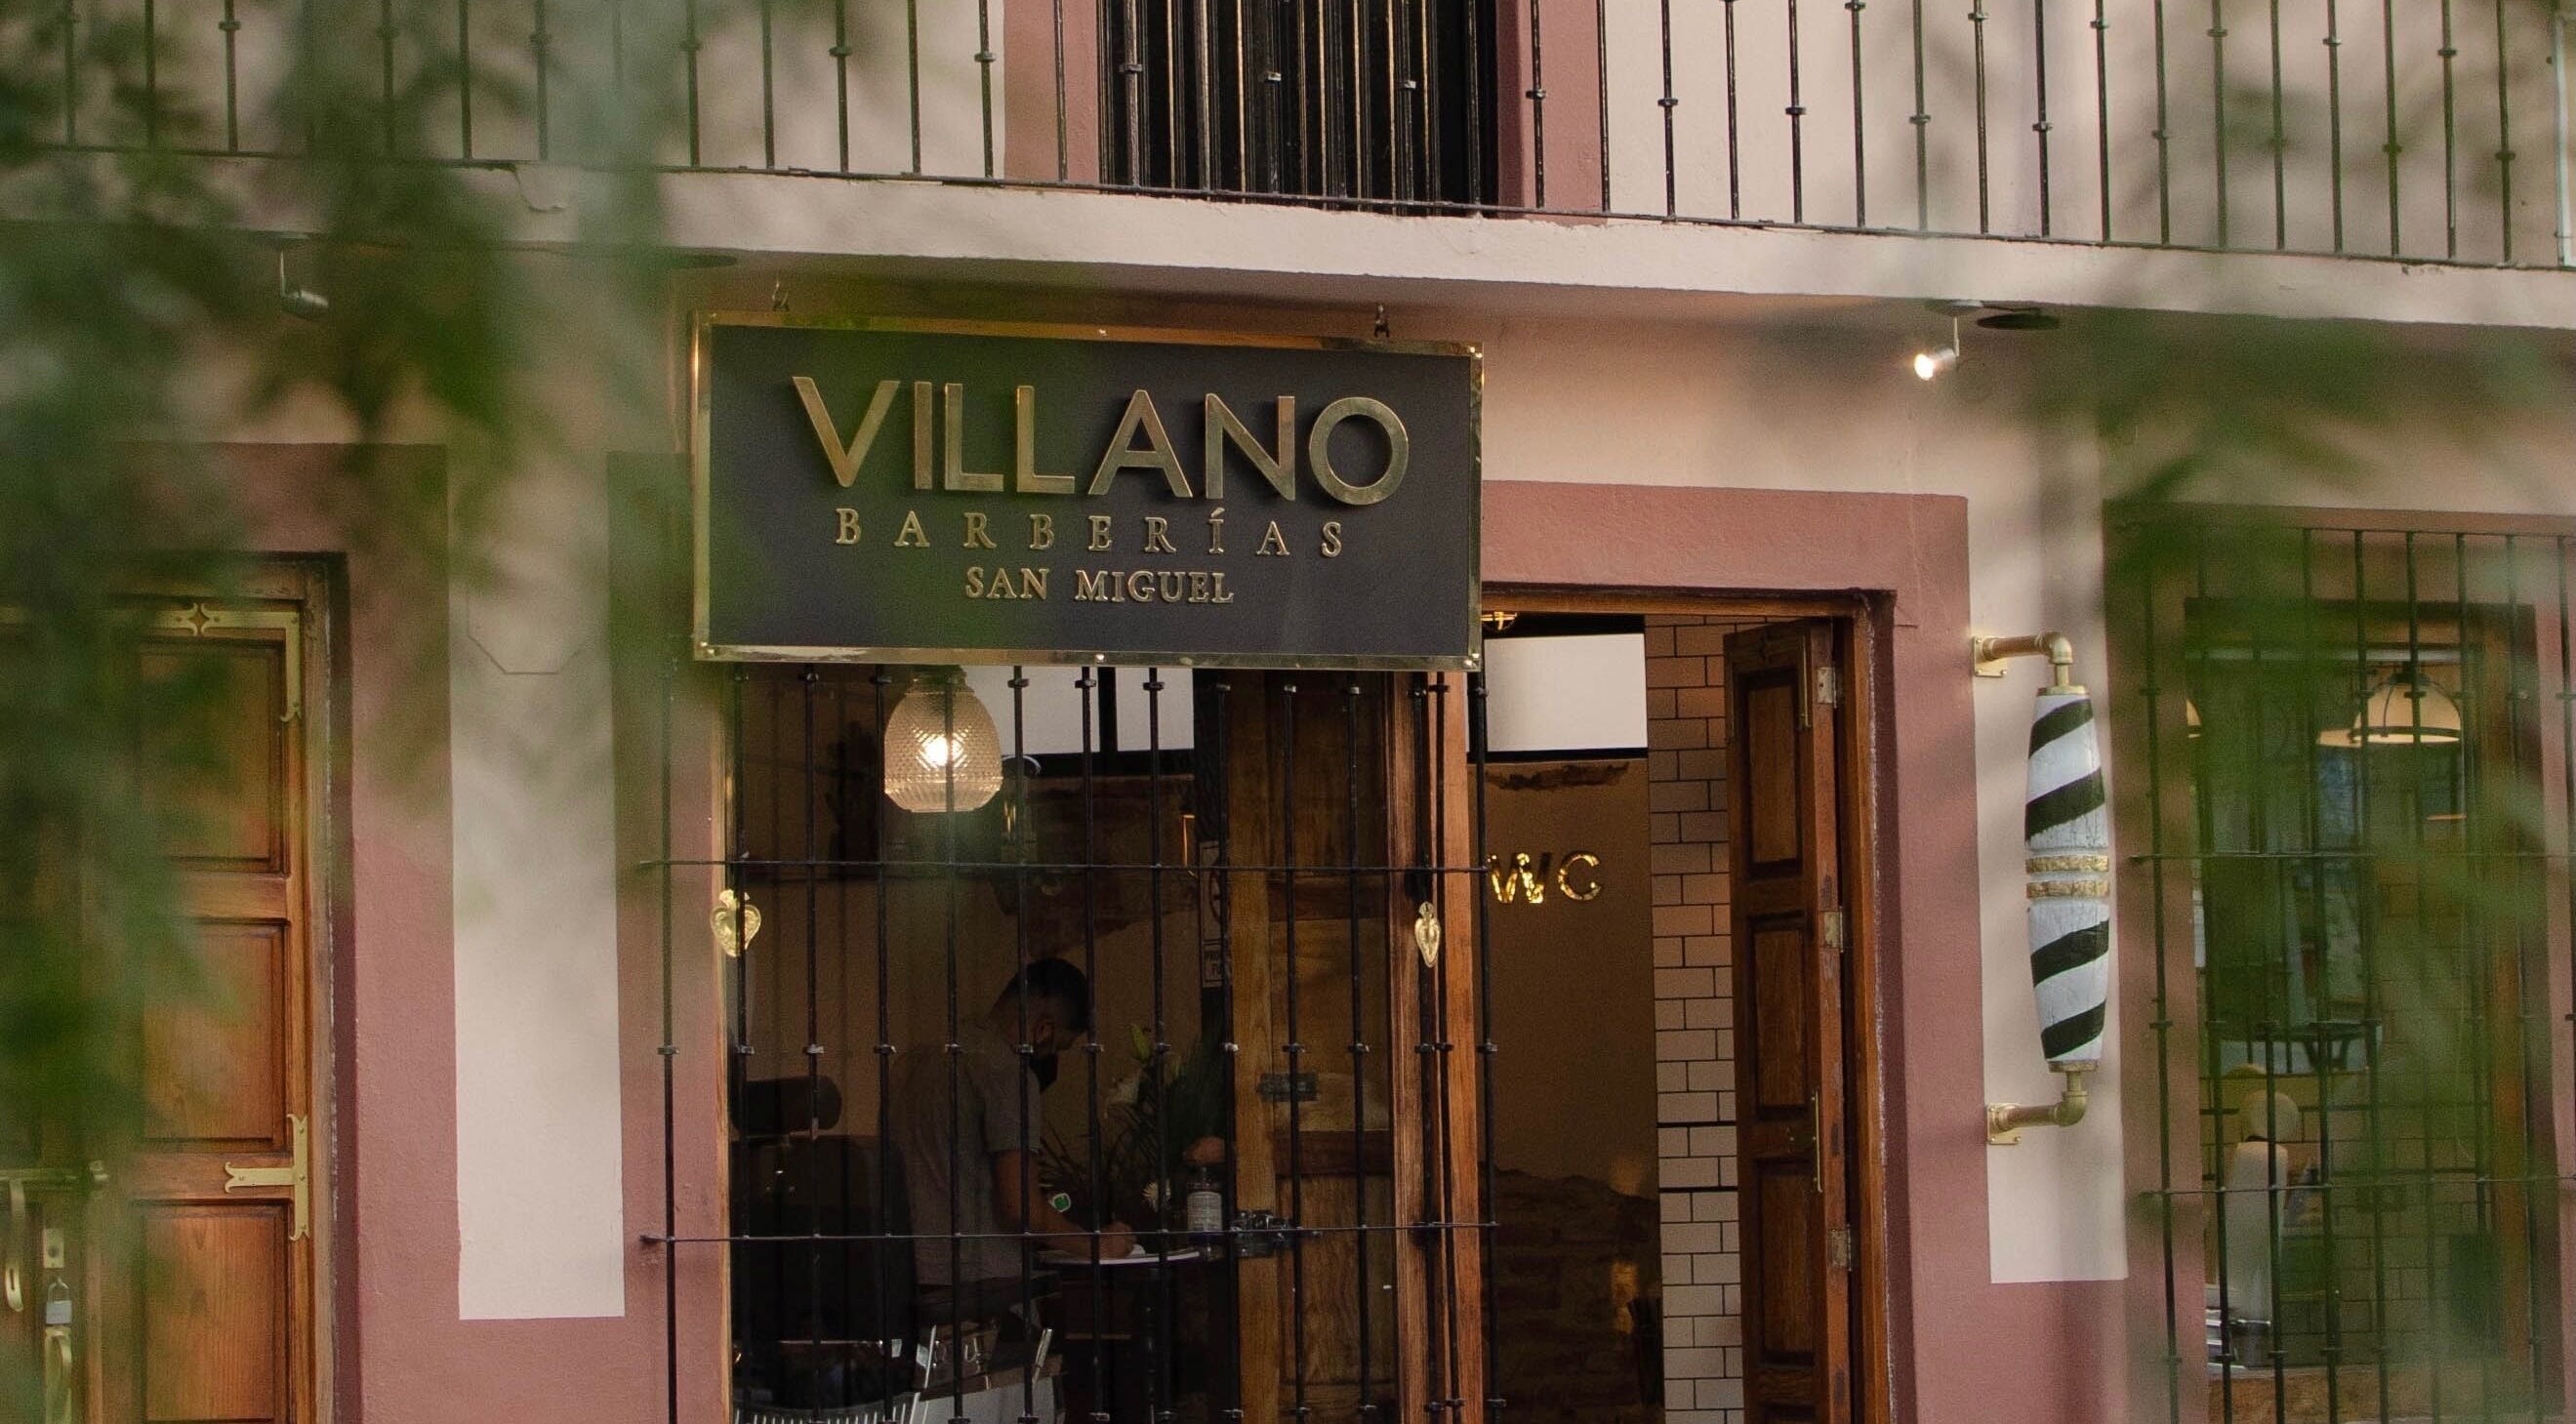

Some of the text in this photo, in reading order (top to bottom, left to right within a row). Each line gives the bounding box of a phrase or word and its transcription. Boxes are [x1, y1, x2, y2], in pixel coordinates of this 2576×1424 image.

[792, 376, 1410, 506] VILLANO
[835, 507, 1343, 558] BARBERÍAS
[964, 566, 1235, 604] SAN MIGUEL
[1486, 851, 1602, 904] WC
